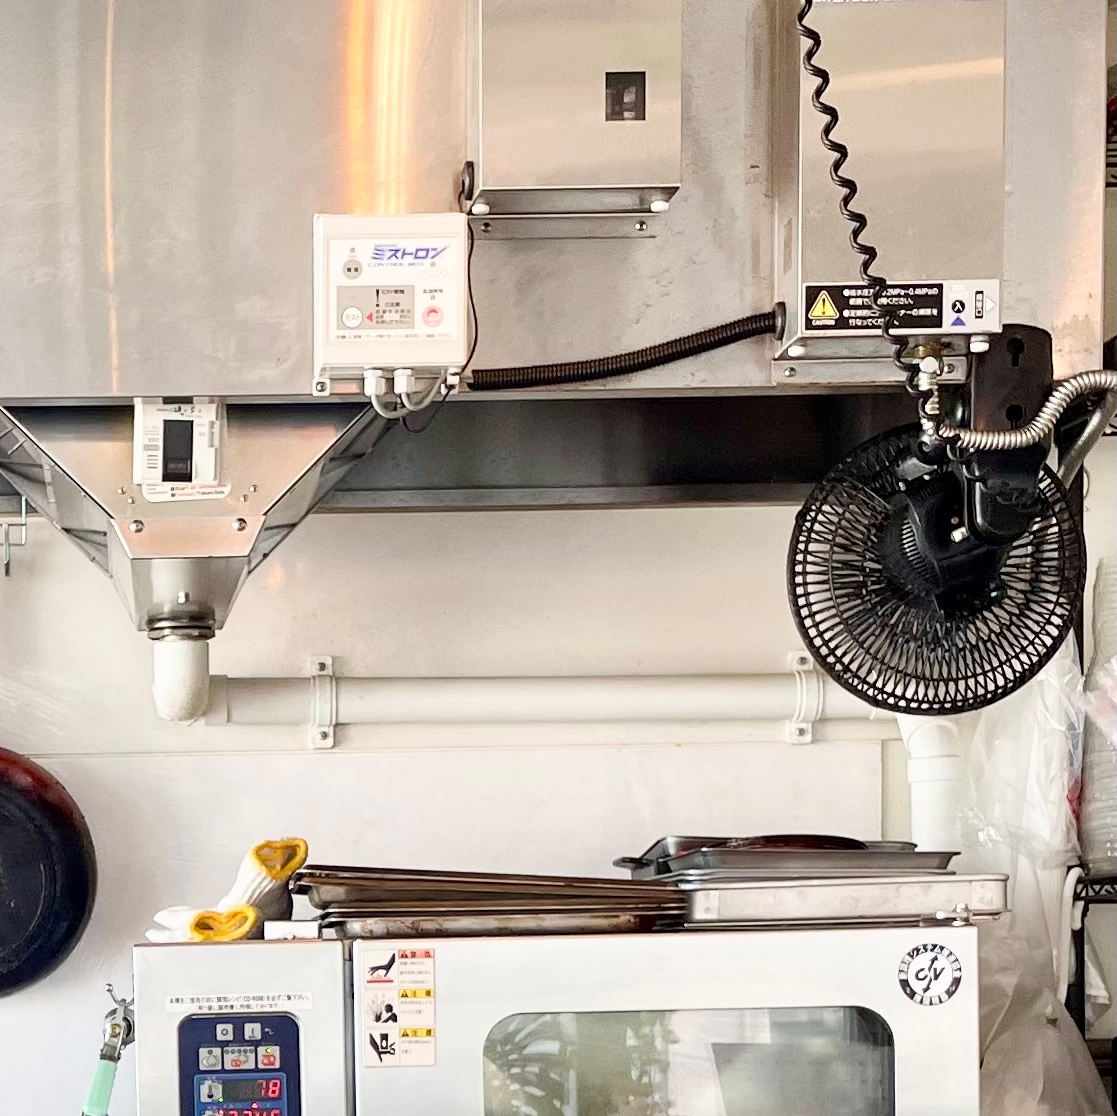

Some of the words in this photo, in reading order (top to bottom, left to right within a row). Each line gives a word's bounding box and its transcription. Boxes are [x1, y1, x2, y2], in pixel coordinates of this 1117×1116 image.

[371, 244, 451, 260] ミストロン
